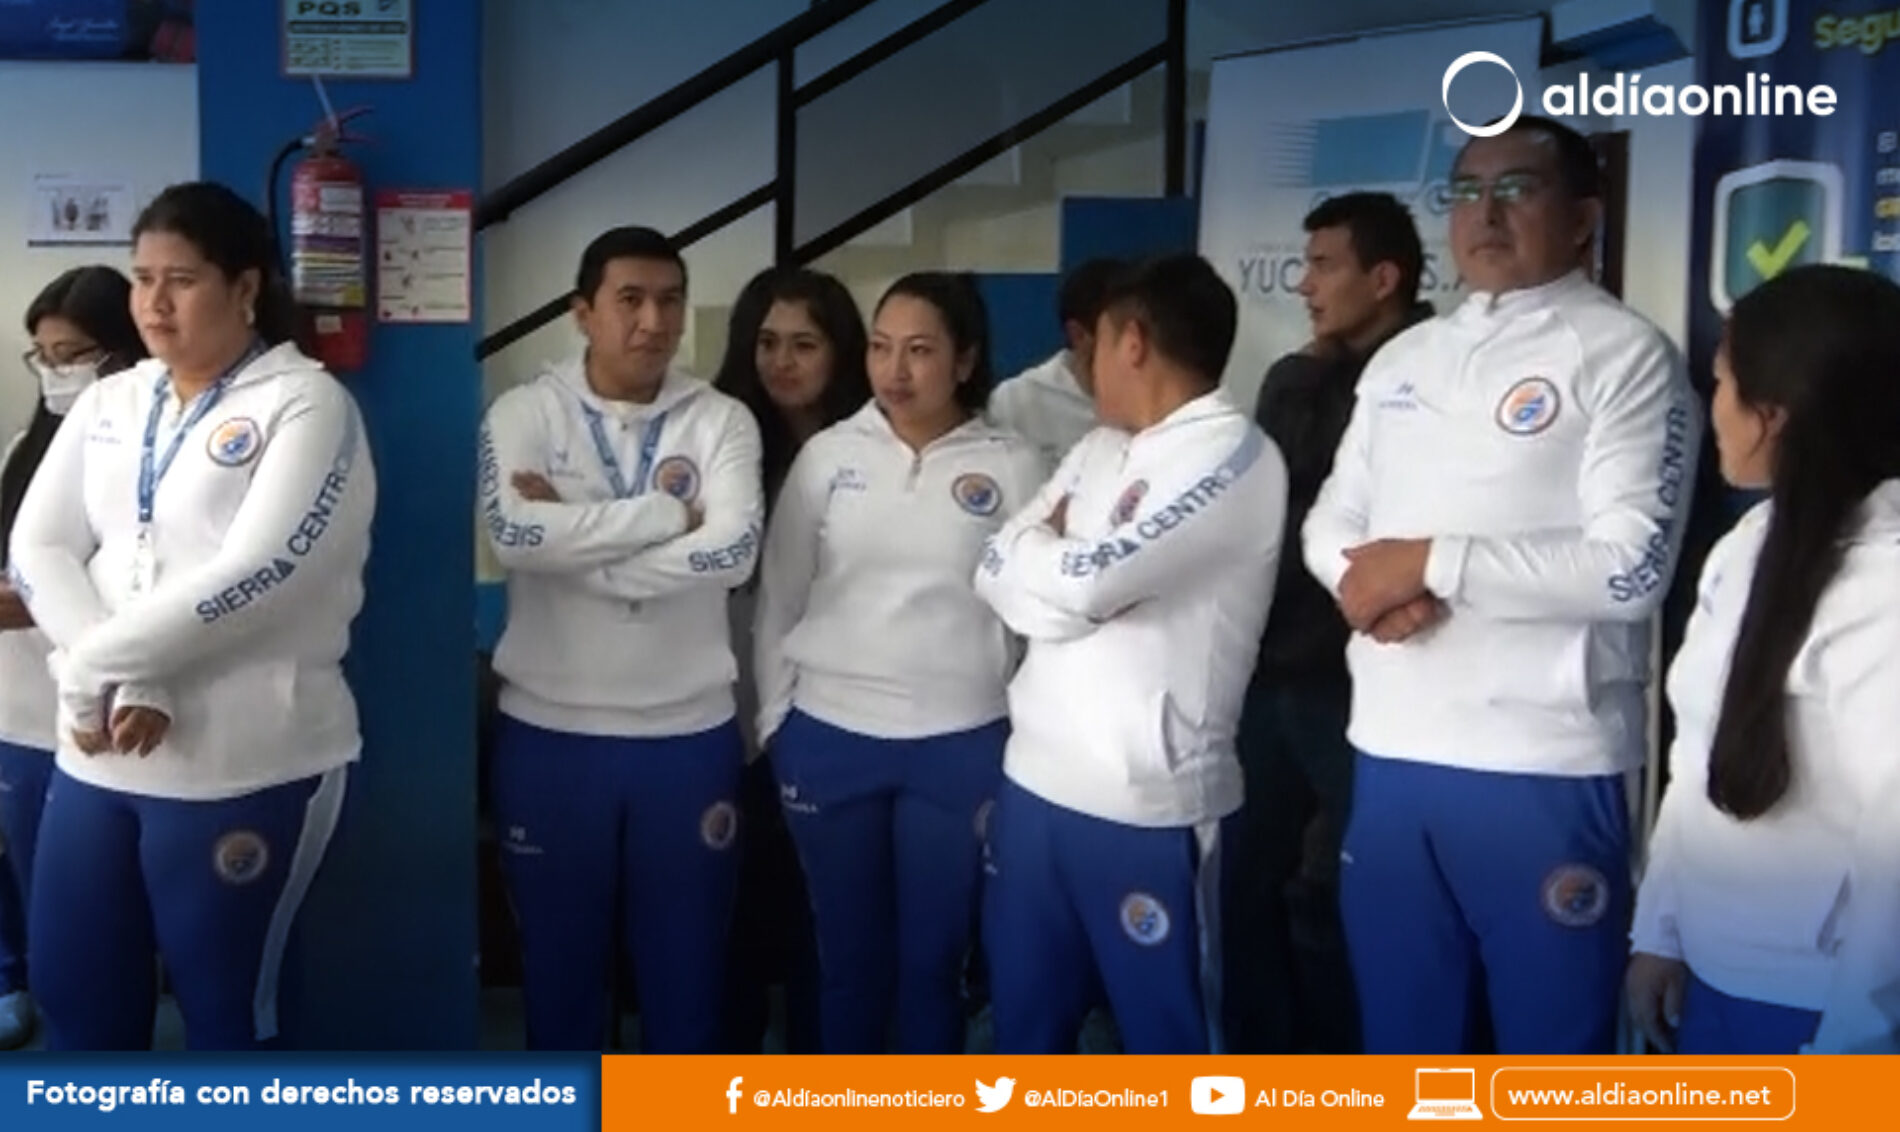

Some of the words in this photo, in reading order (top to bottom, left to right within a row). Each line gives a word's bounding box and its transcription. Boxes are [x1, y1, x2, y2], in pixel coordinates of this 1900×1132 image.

[1813, 9, 1900, 54] Segu
[1658, 405, 1688, 507] CENTR
[195, 557, 296, 624] SIERRA
